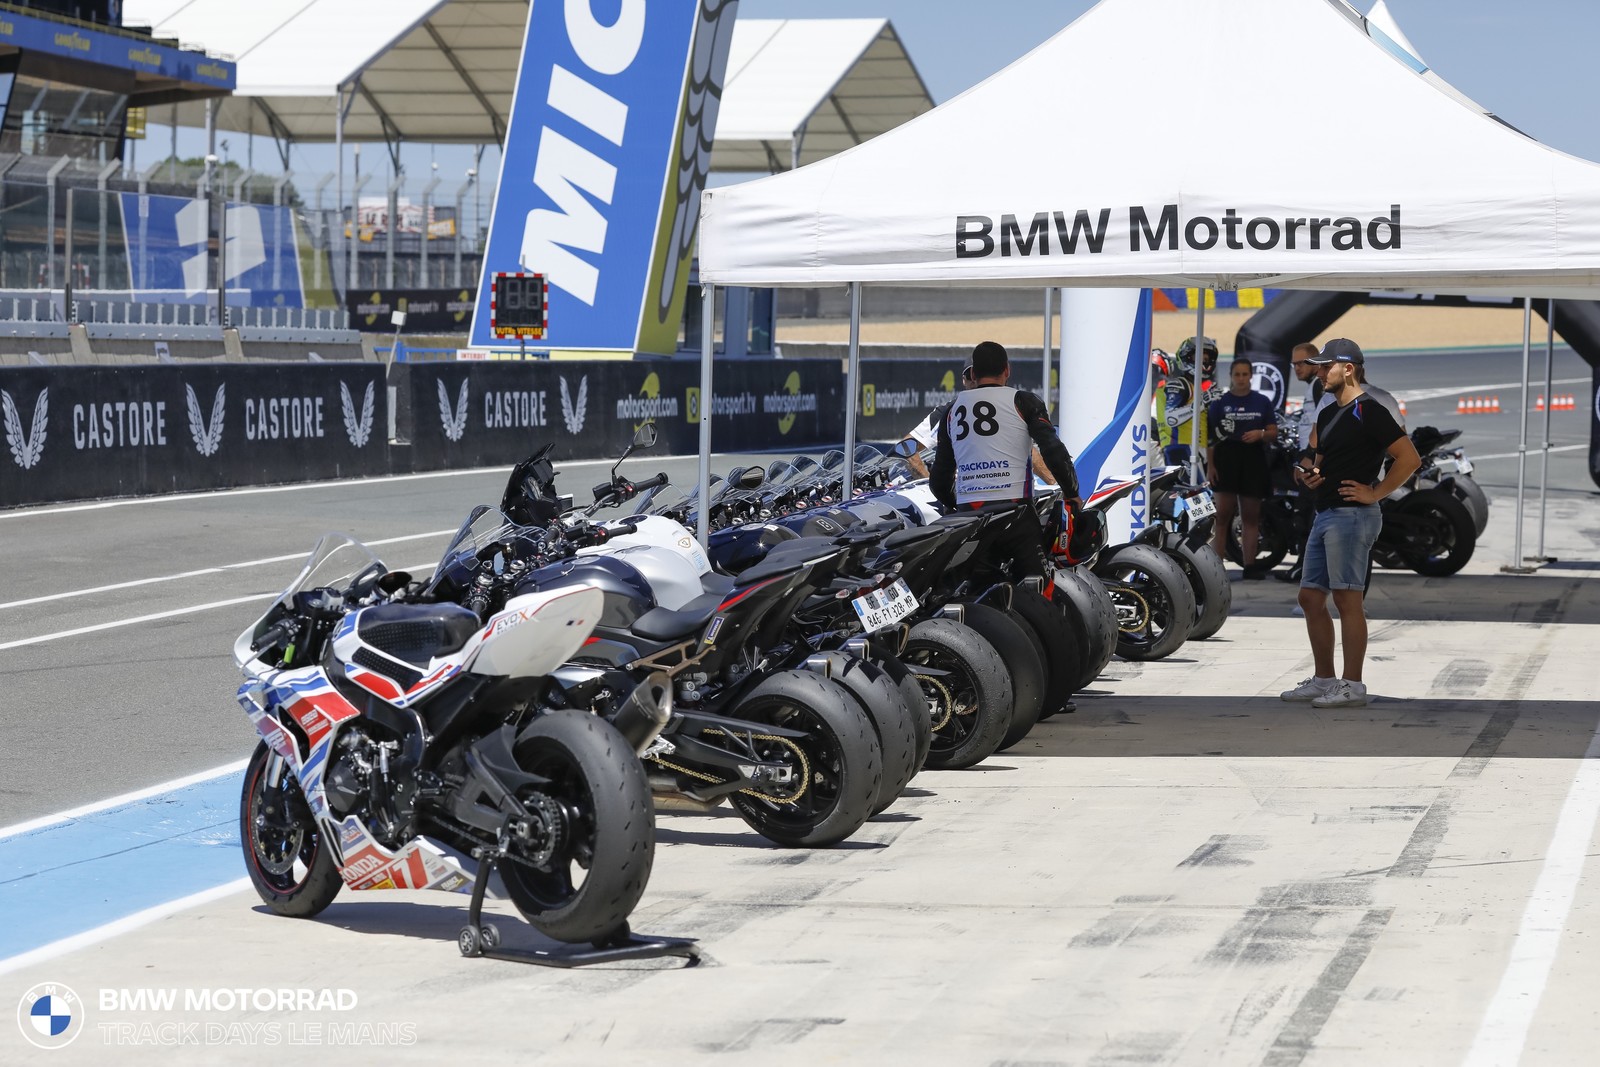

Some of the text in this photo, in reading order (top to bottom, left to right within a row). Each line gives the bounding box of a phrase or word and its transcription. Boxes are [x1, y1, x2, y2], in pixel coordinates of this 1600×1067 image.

[956, 204, 1401, 258] BMW Motorrad
[73, 401, 167, 449] CASTORE
[245, 397, 324, 440] CASTORE
[485, 391, 547, 428] CASTORE
[711, 393, 757, 420] otorsport.tv
[955, 401, 999, 440] 38
